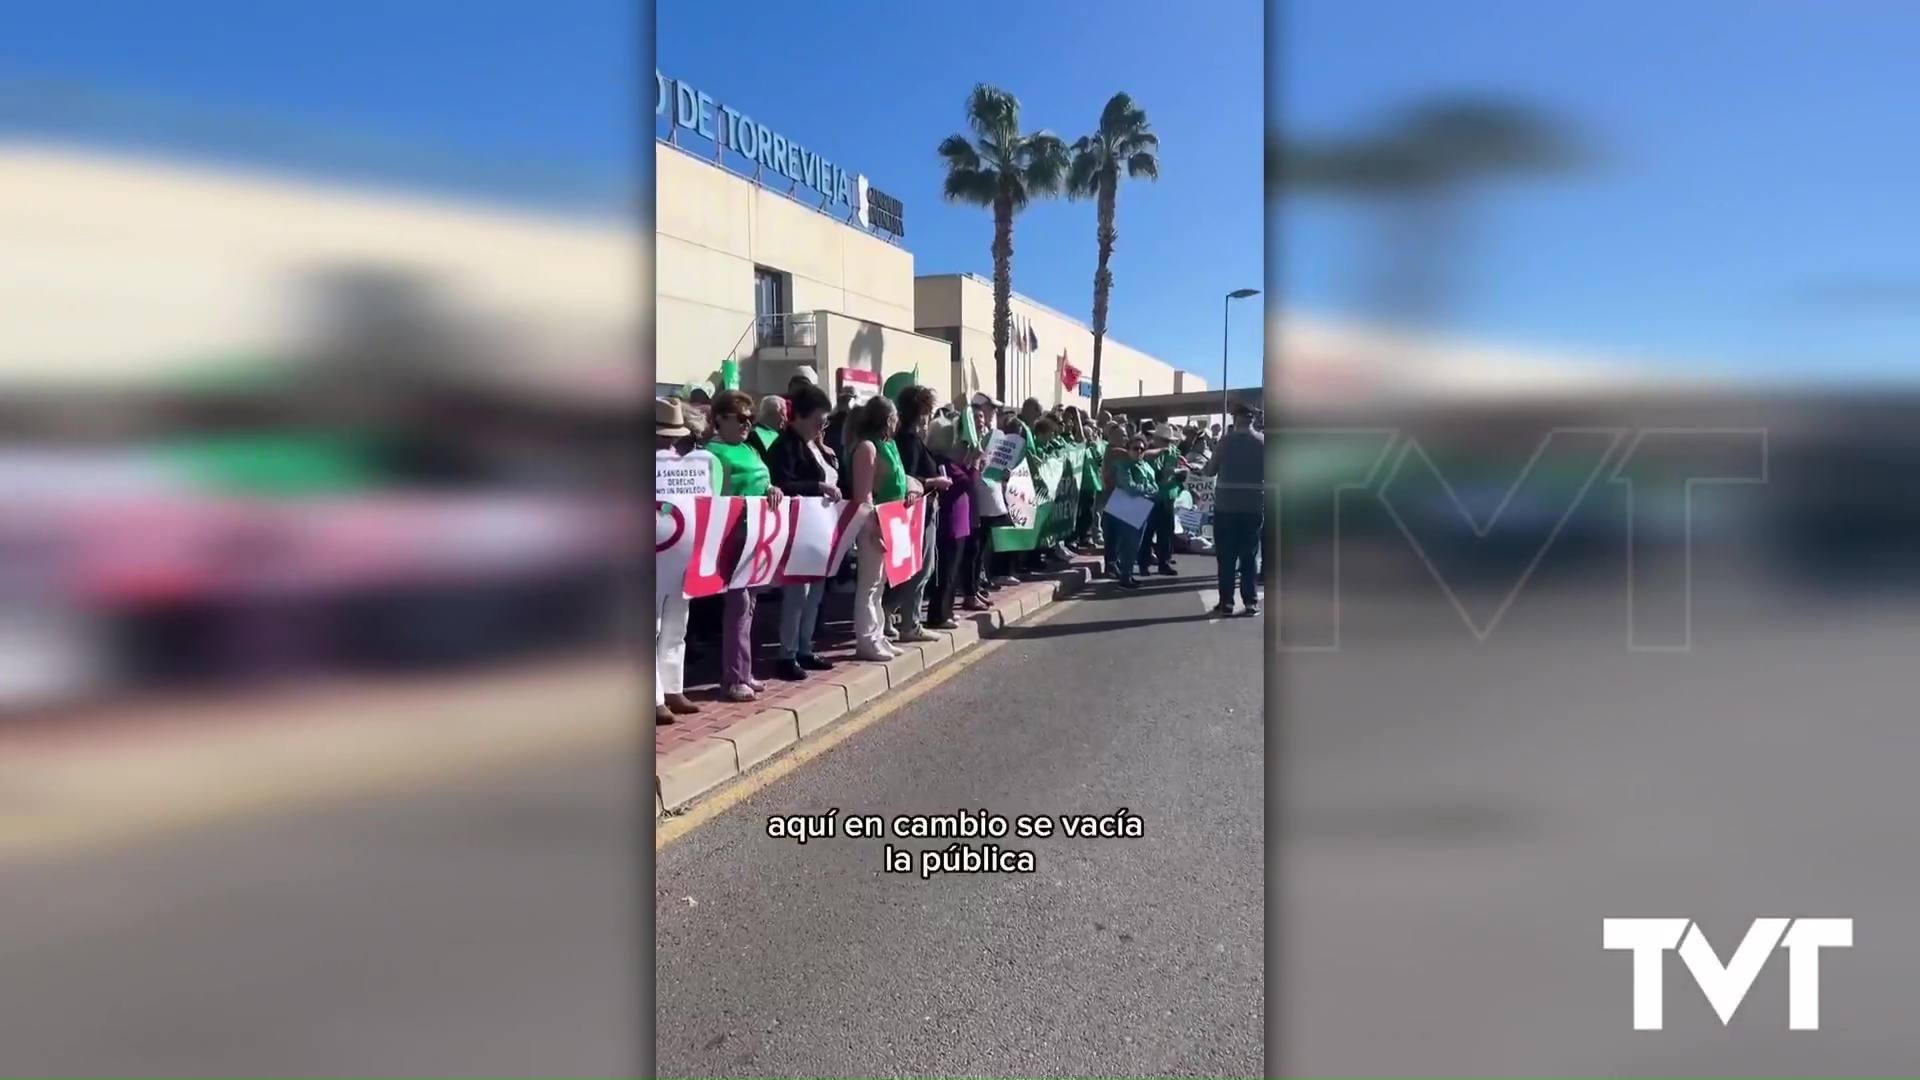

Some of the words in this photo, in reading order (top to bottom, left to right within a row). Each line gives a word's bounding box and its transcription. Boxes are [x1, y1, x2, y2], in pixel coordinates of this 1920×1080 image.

[674, 78, 715, 141] DE
[720, 103, 851, 206] TORREVIEJA
[663, 469, 688, 477] SANIDAD
[689, 469, 697, 477] ES
[697, 469, 706, 477] UN
[667, 478, 695, 486] DERECHO
